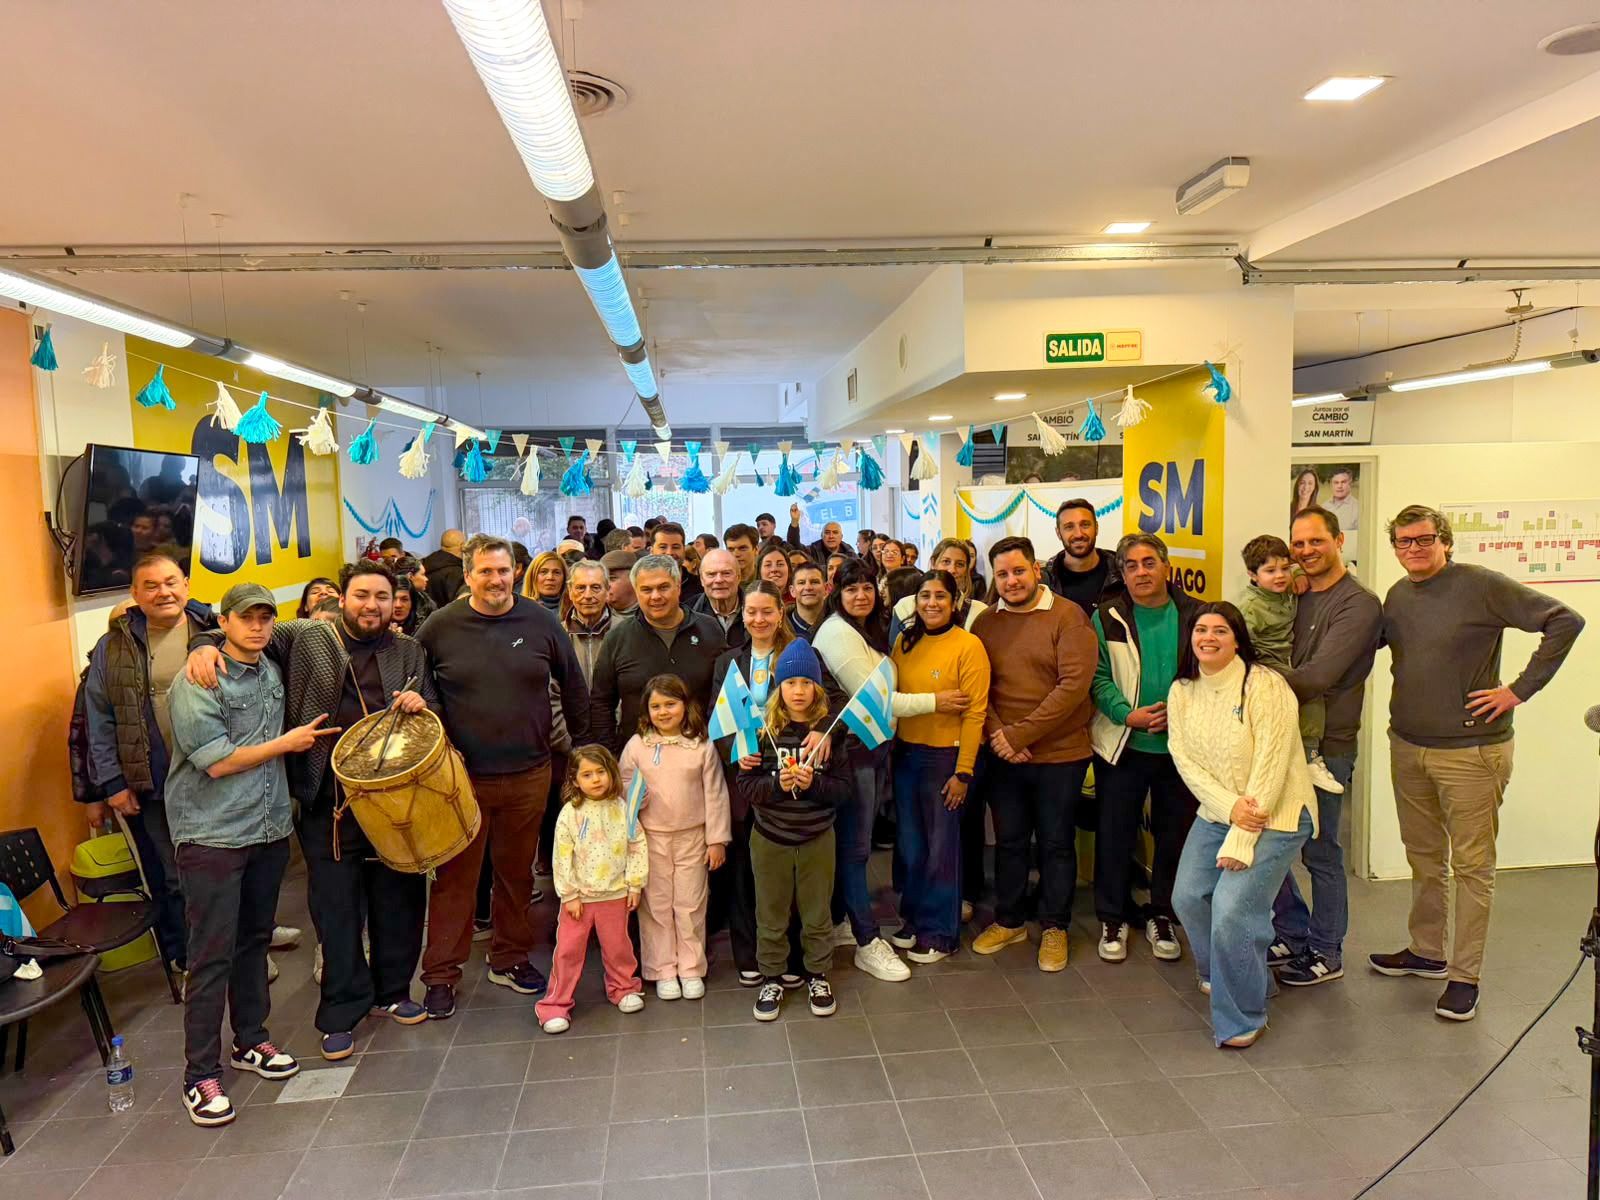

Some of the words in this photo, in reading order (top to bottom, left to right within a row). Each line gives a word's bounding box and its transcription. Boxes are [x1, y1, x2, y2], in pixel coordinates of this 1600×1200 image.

[1048, 338, 1102, 357] SALIDA
[1039, 415, 1074, 424] AMBIO
[1312, 412, 1349, 421] CAMBIO
[1304, 430, 1321, 438] SAN
[1322, 427, 1354, 438] MARTÍN
[191, 413, 312, 575] SM
[1137, 458, 1205, 536] SM
[1309, 961, 1330, 978] N
